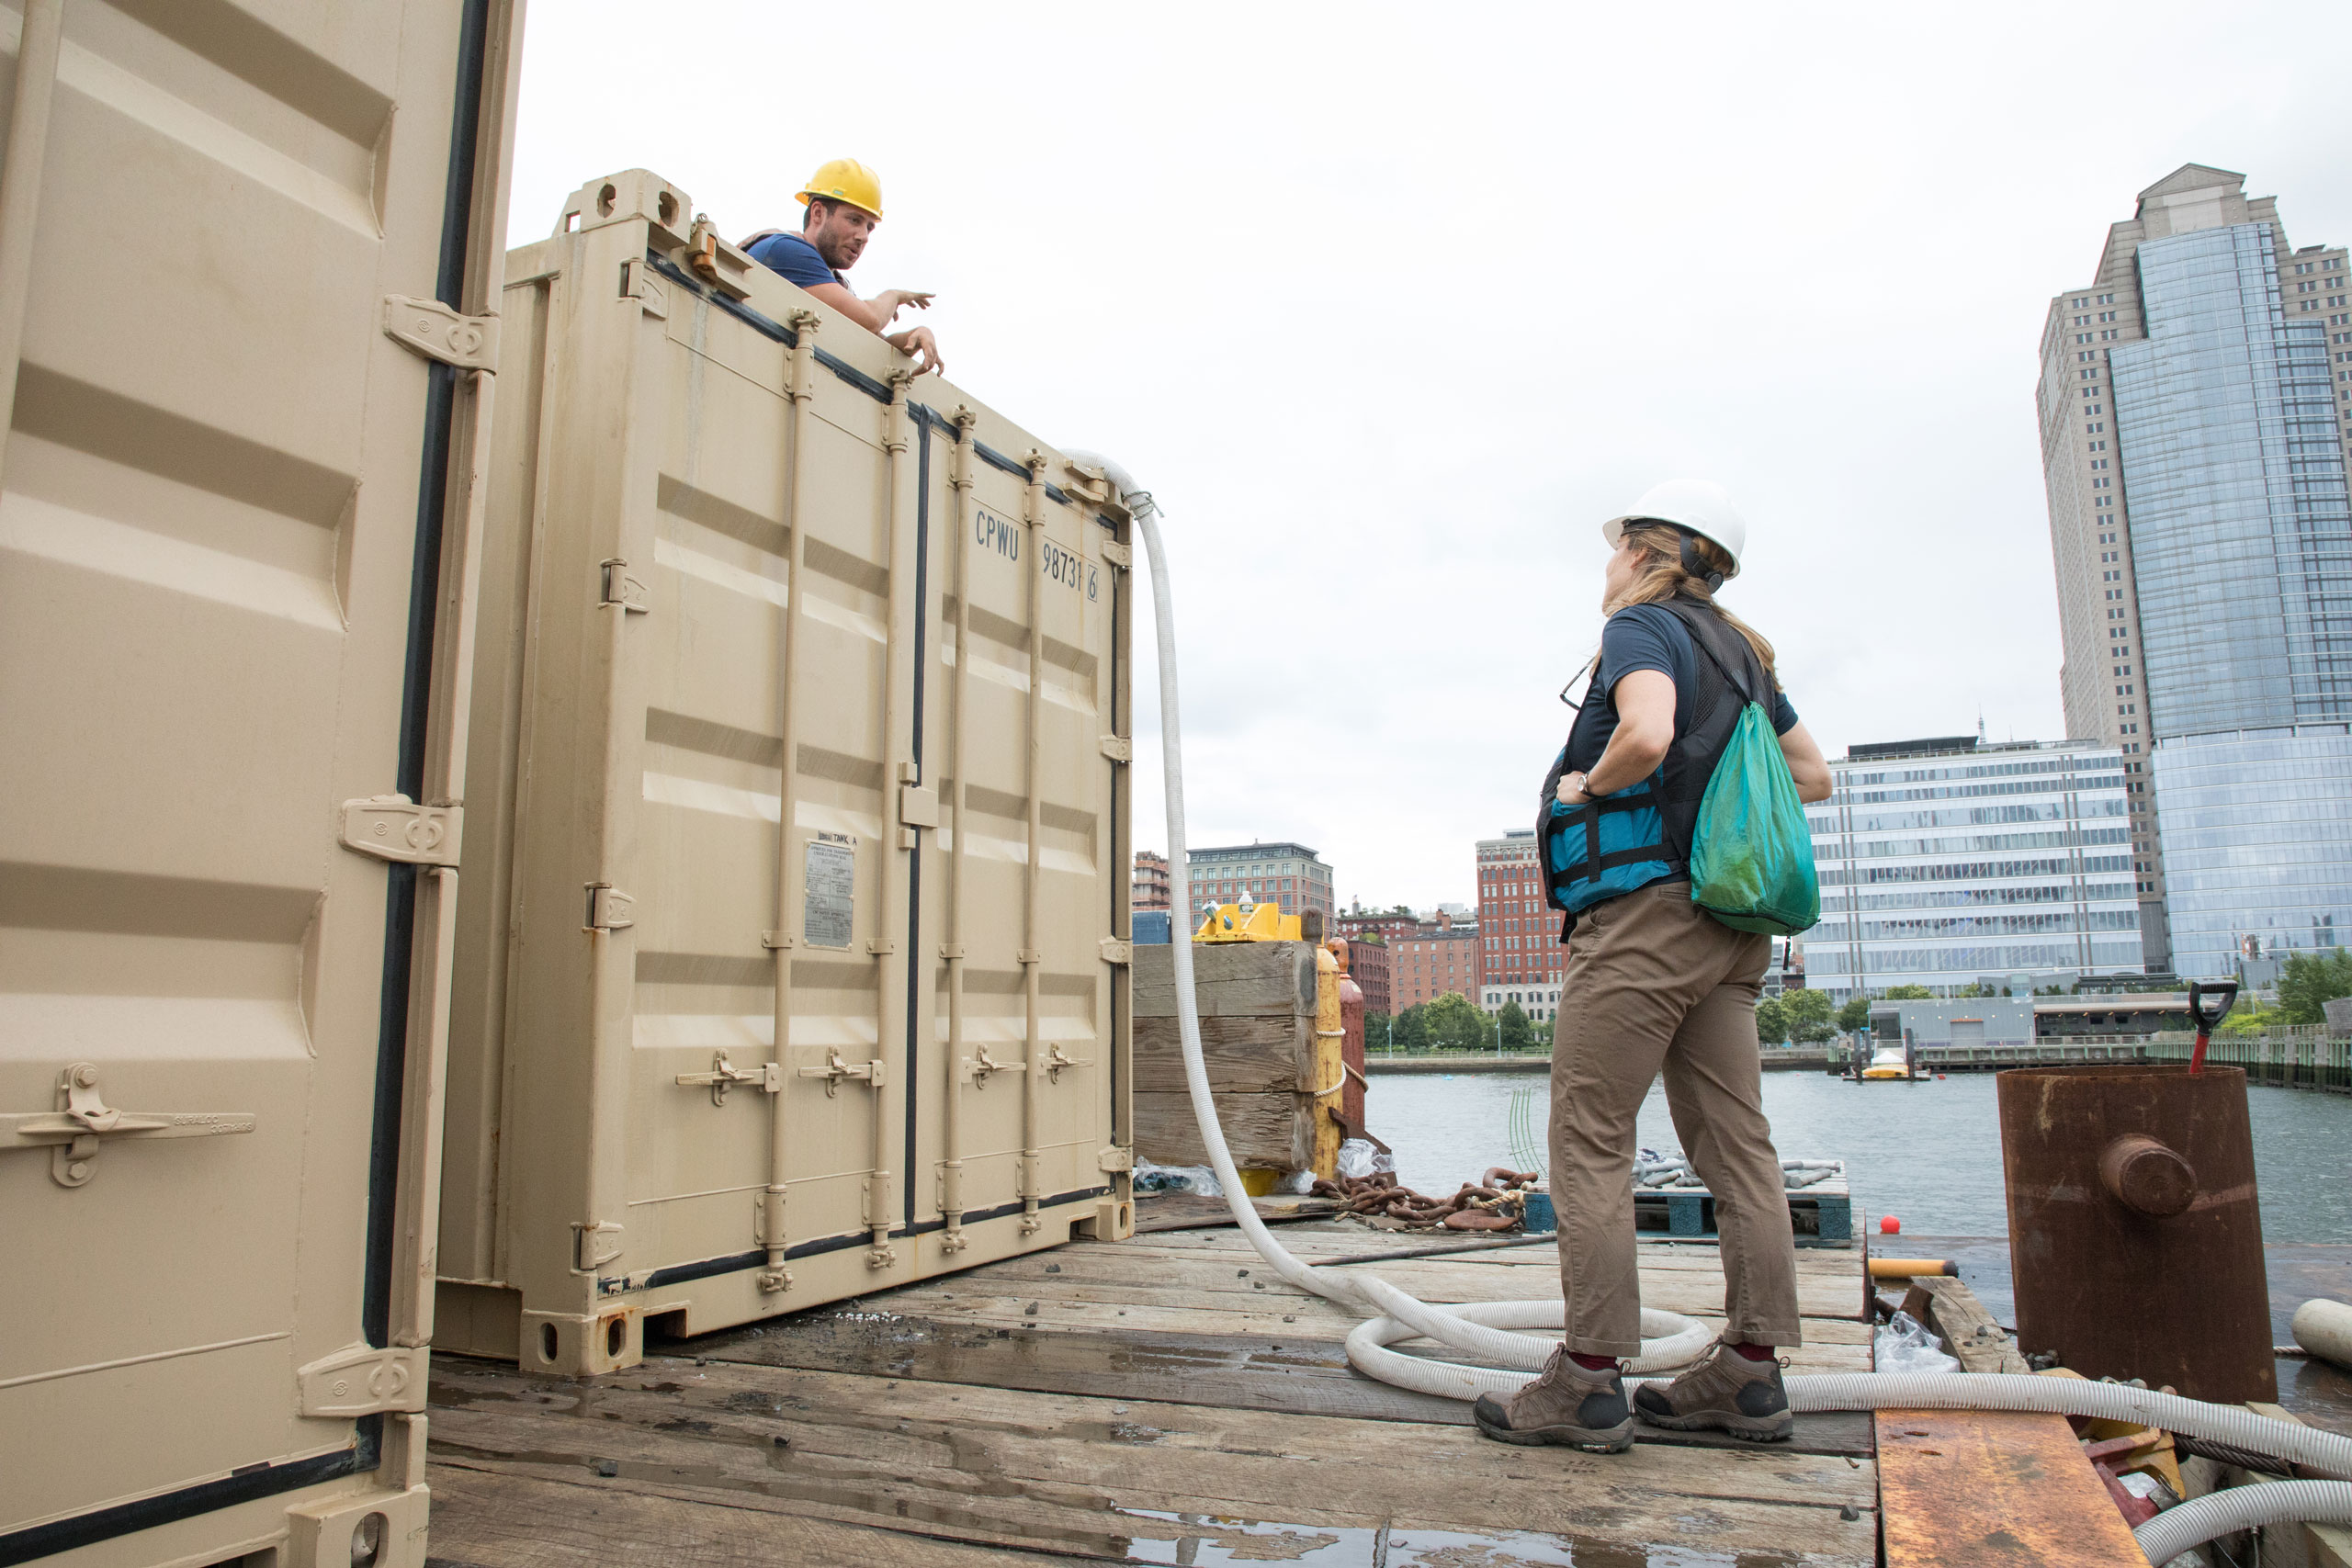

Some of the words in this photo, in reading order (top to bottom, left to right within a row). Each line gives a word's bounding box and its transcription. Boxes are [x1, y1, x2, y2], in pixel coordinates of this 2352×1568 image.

[977, 511, 1018, 561] CPWU
[1043, 543, 1081, 592] 98731
[1088, 570, 1097, 599] 6
[833, 834, 849, 844] TANK
[853, 837, 857, 845] A
